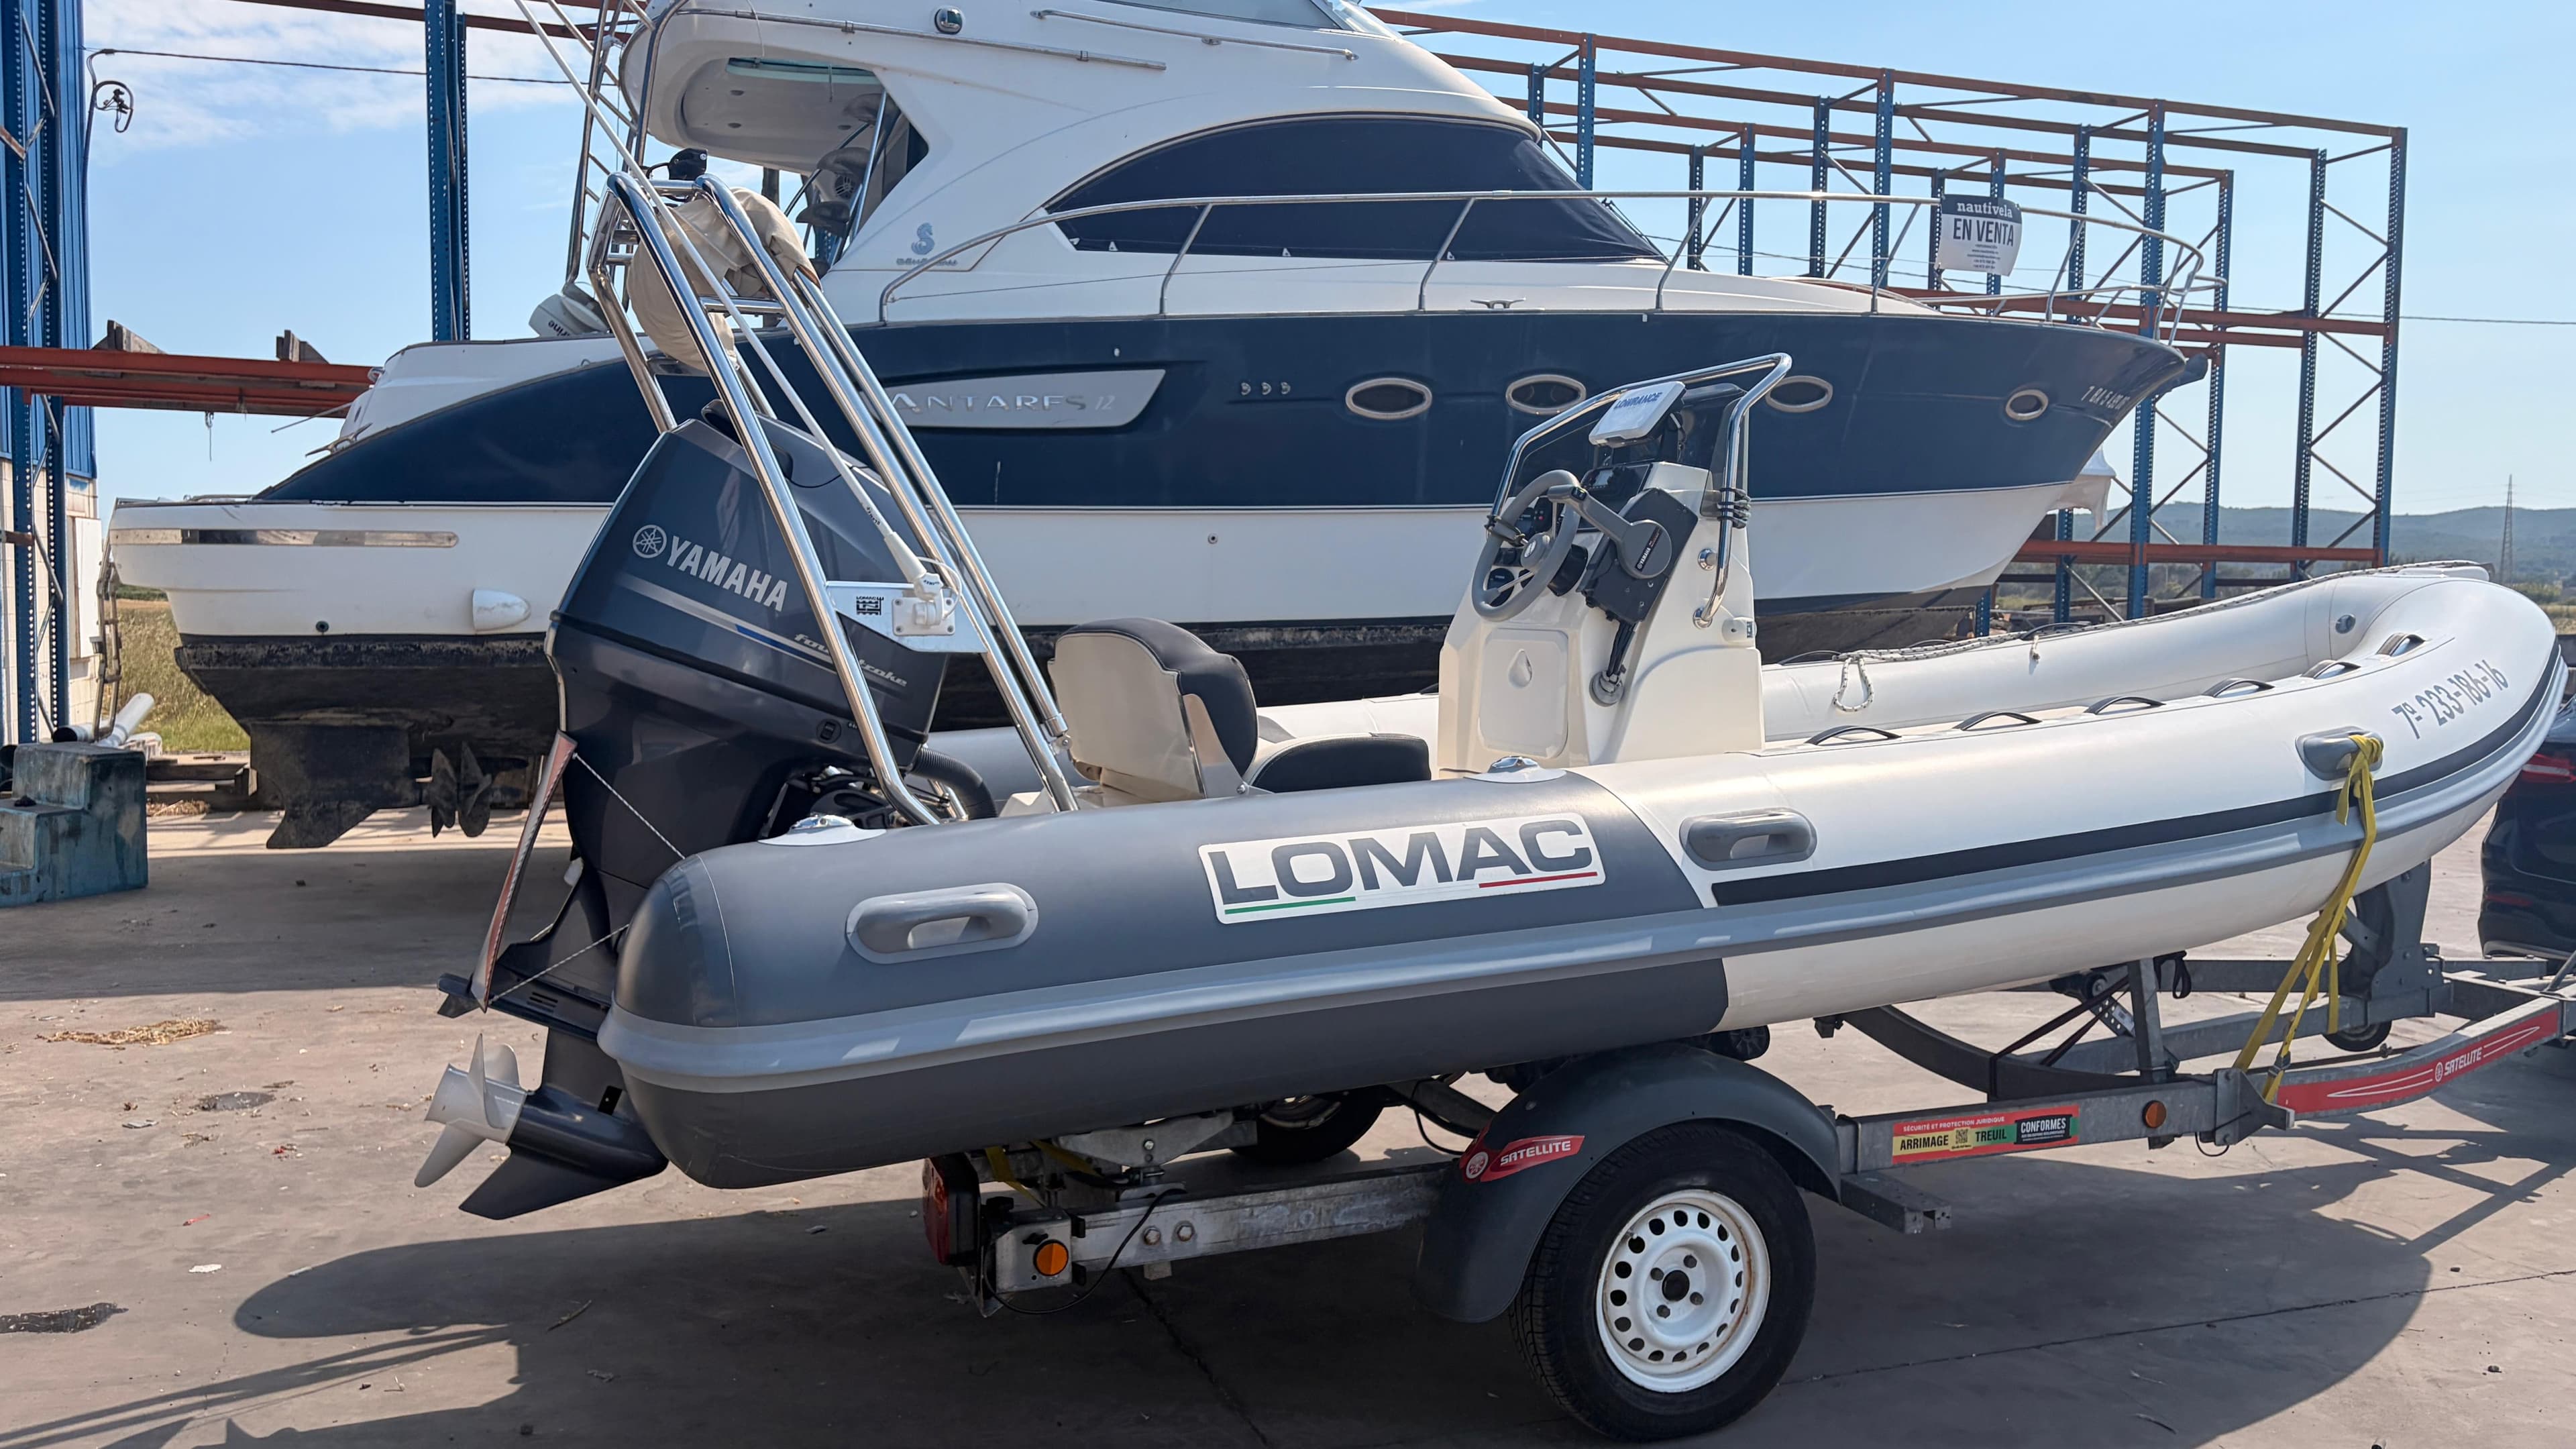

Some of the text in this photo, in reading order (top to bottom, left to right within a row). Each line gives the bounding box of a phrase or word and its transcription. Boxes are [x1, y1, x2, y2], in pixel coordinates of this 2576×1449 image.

[1957, 201, 2013, 219] nautivela
[1953, 218, 2014, 247] EN VENTA
[892, 392, 1116, 414] ANTARES 12
[1613, 392, 1663, 410] LOWRANCE
[1640, 547, 1651, 564] YAMAHA
[667, 535, 788, 612] YAMAHA
[1207, 819, 1593, 906] LOMAC
[2444, 1046, 2483, 1076] SATELLITE
[1903, 1123, 1930, 1132] SÉCURITÉ
[1939, 1120, 1975, 1128] PROTECTION
[1976, 1116, 2005, 1126] JURIDIQUE
[2021, 1117, 2067, 1134] CONFORMES
[1900, 1134, 1949, 1150] ARRIMAGE
[1975, 1128, 2007, 1142] TREUIL
[1500, 1140, 1572, 1166] SATELLITE
